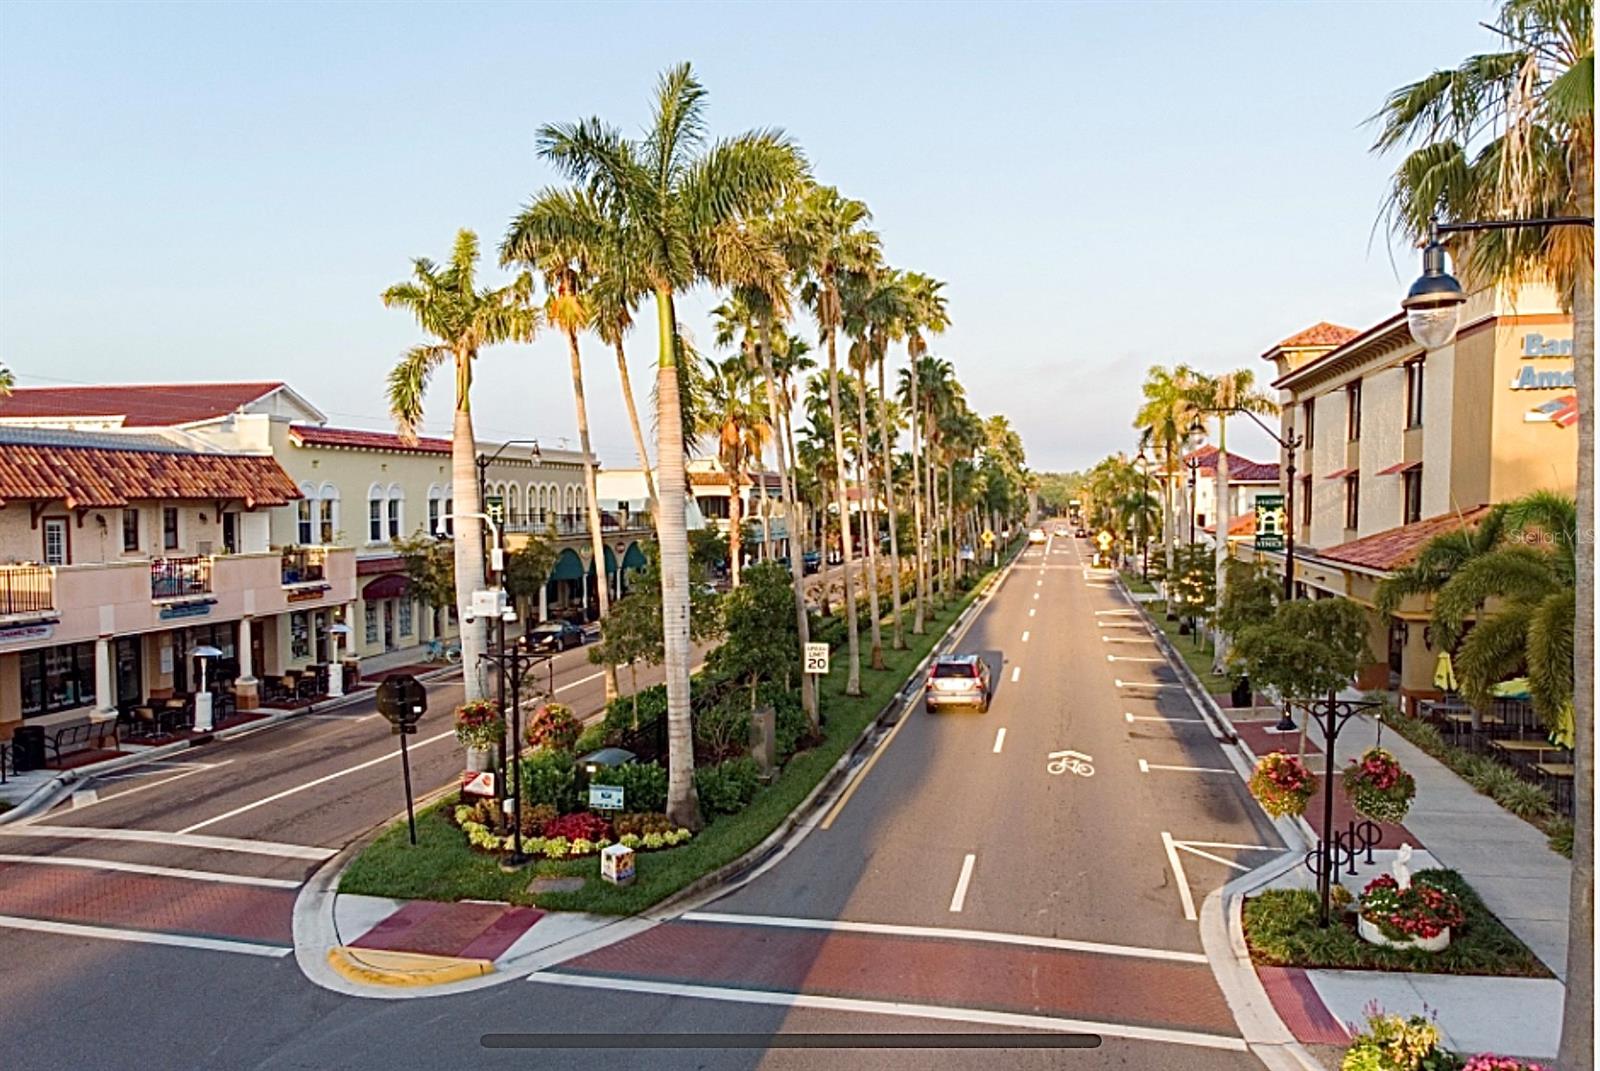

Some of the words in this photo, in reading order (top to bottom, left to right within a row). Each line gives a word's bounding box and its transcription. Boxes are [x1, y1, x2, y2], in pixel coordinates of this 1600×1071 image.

[1524, 333, 1575, 356] Ban
[1518, 365, 1576, 388] Ame
[807, 658, 827, 670] 20
